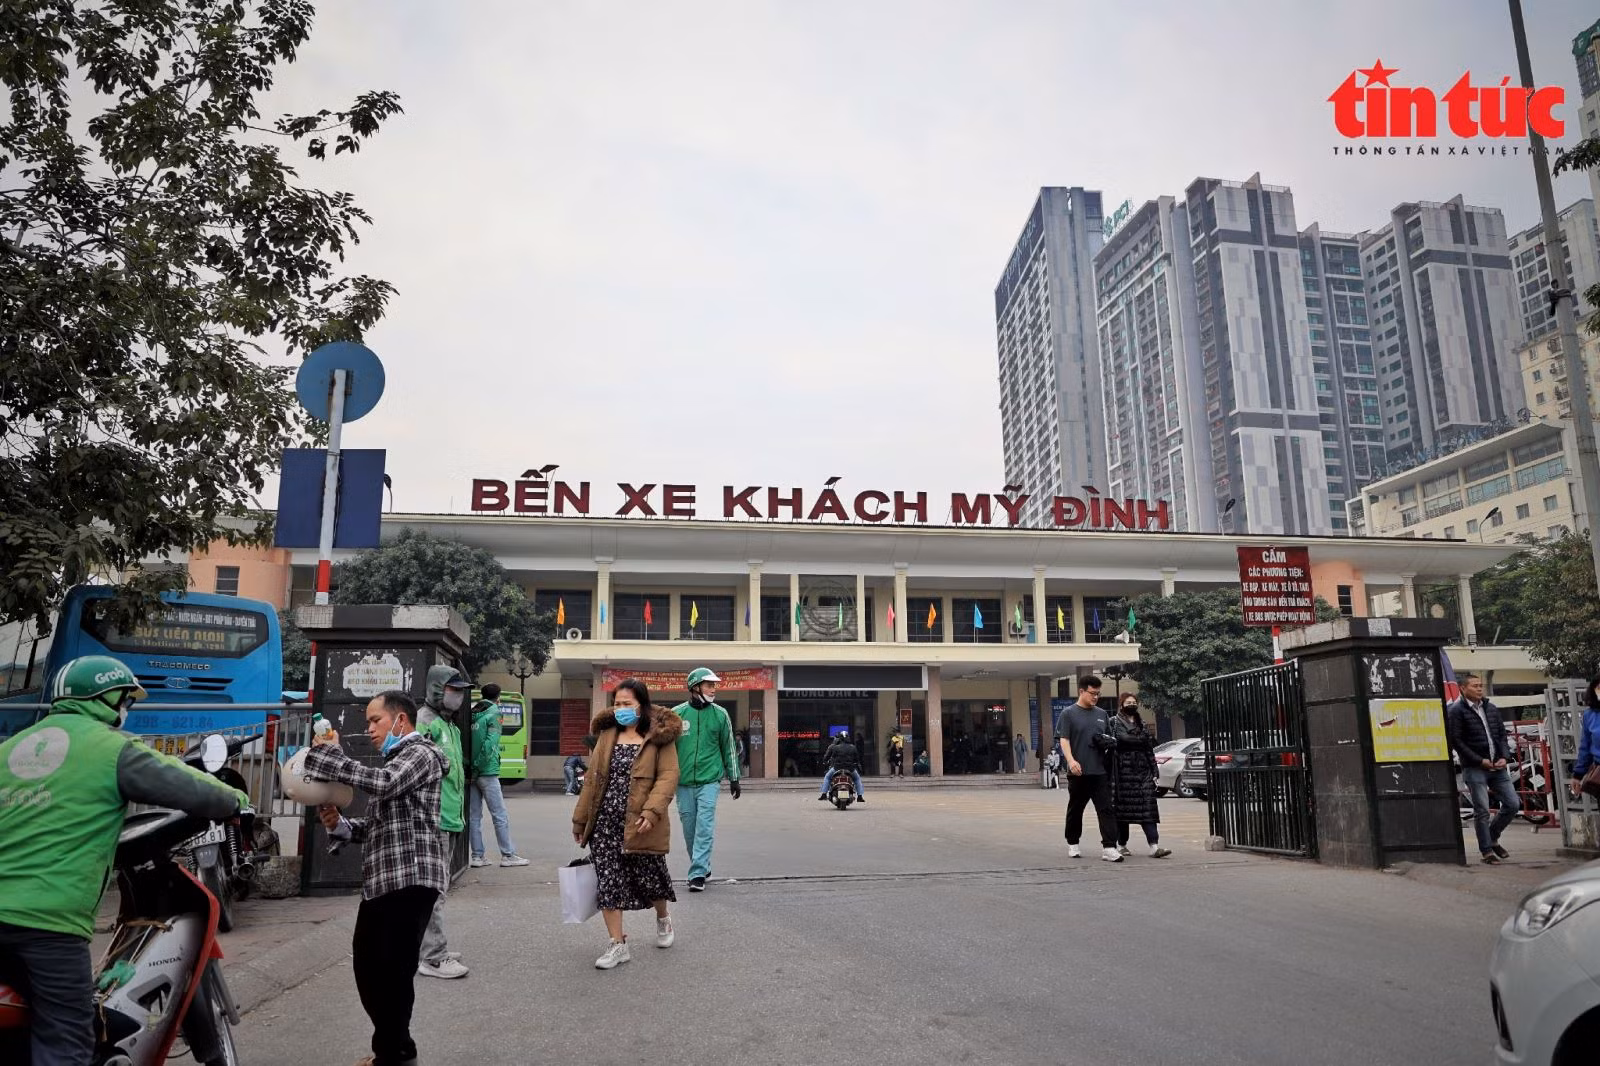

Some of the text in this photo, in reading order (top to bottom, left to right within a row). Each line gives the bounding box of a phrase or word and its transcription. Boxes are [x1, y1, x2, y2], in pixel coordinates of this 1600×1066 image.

[471, 464, 1169, 530] BẾN XE KHÁCH MỸ ĐÌNH
[1248, 565, 1261, 577] CÁC
[1262, 567, 1287, 577] PHƯƠNG
[163, 627, 190, 640] LIÊN
[149, 660, 210, 670] TRACOMECO
[95, 667, 125, 684] Grab
[146, 956, 182, 968] HONDA
